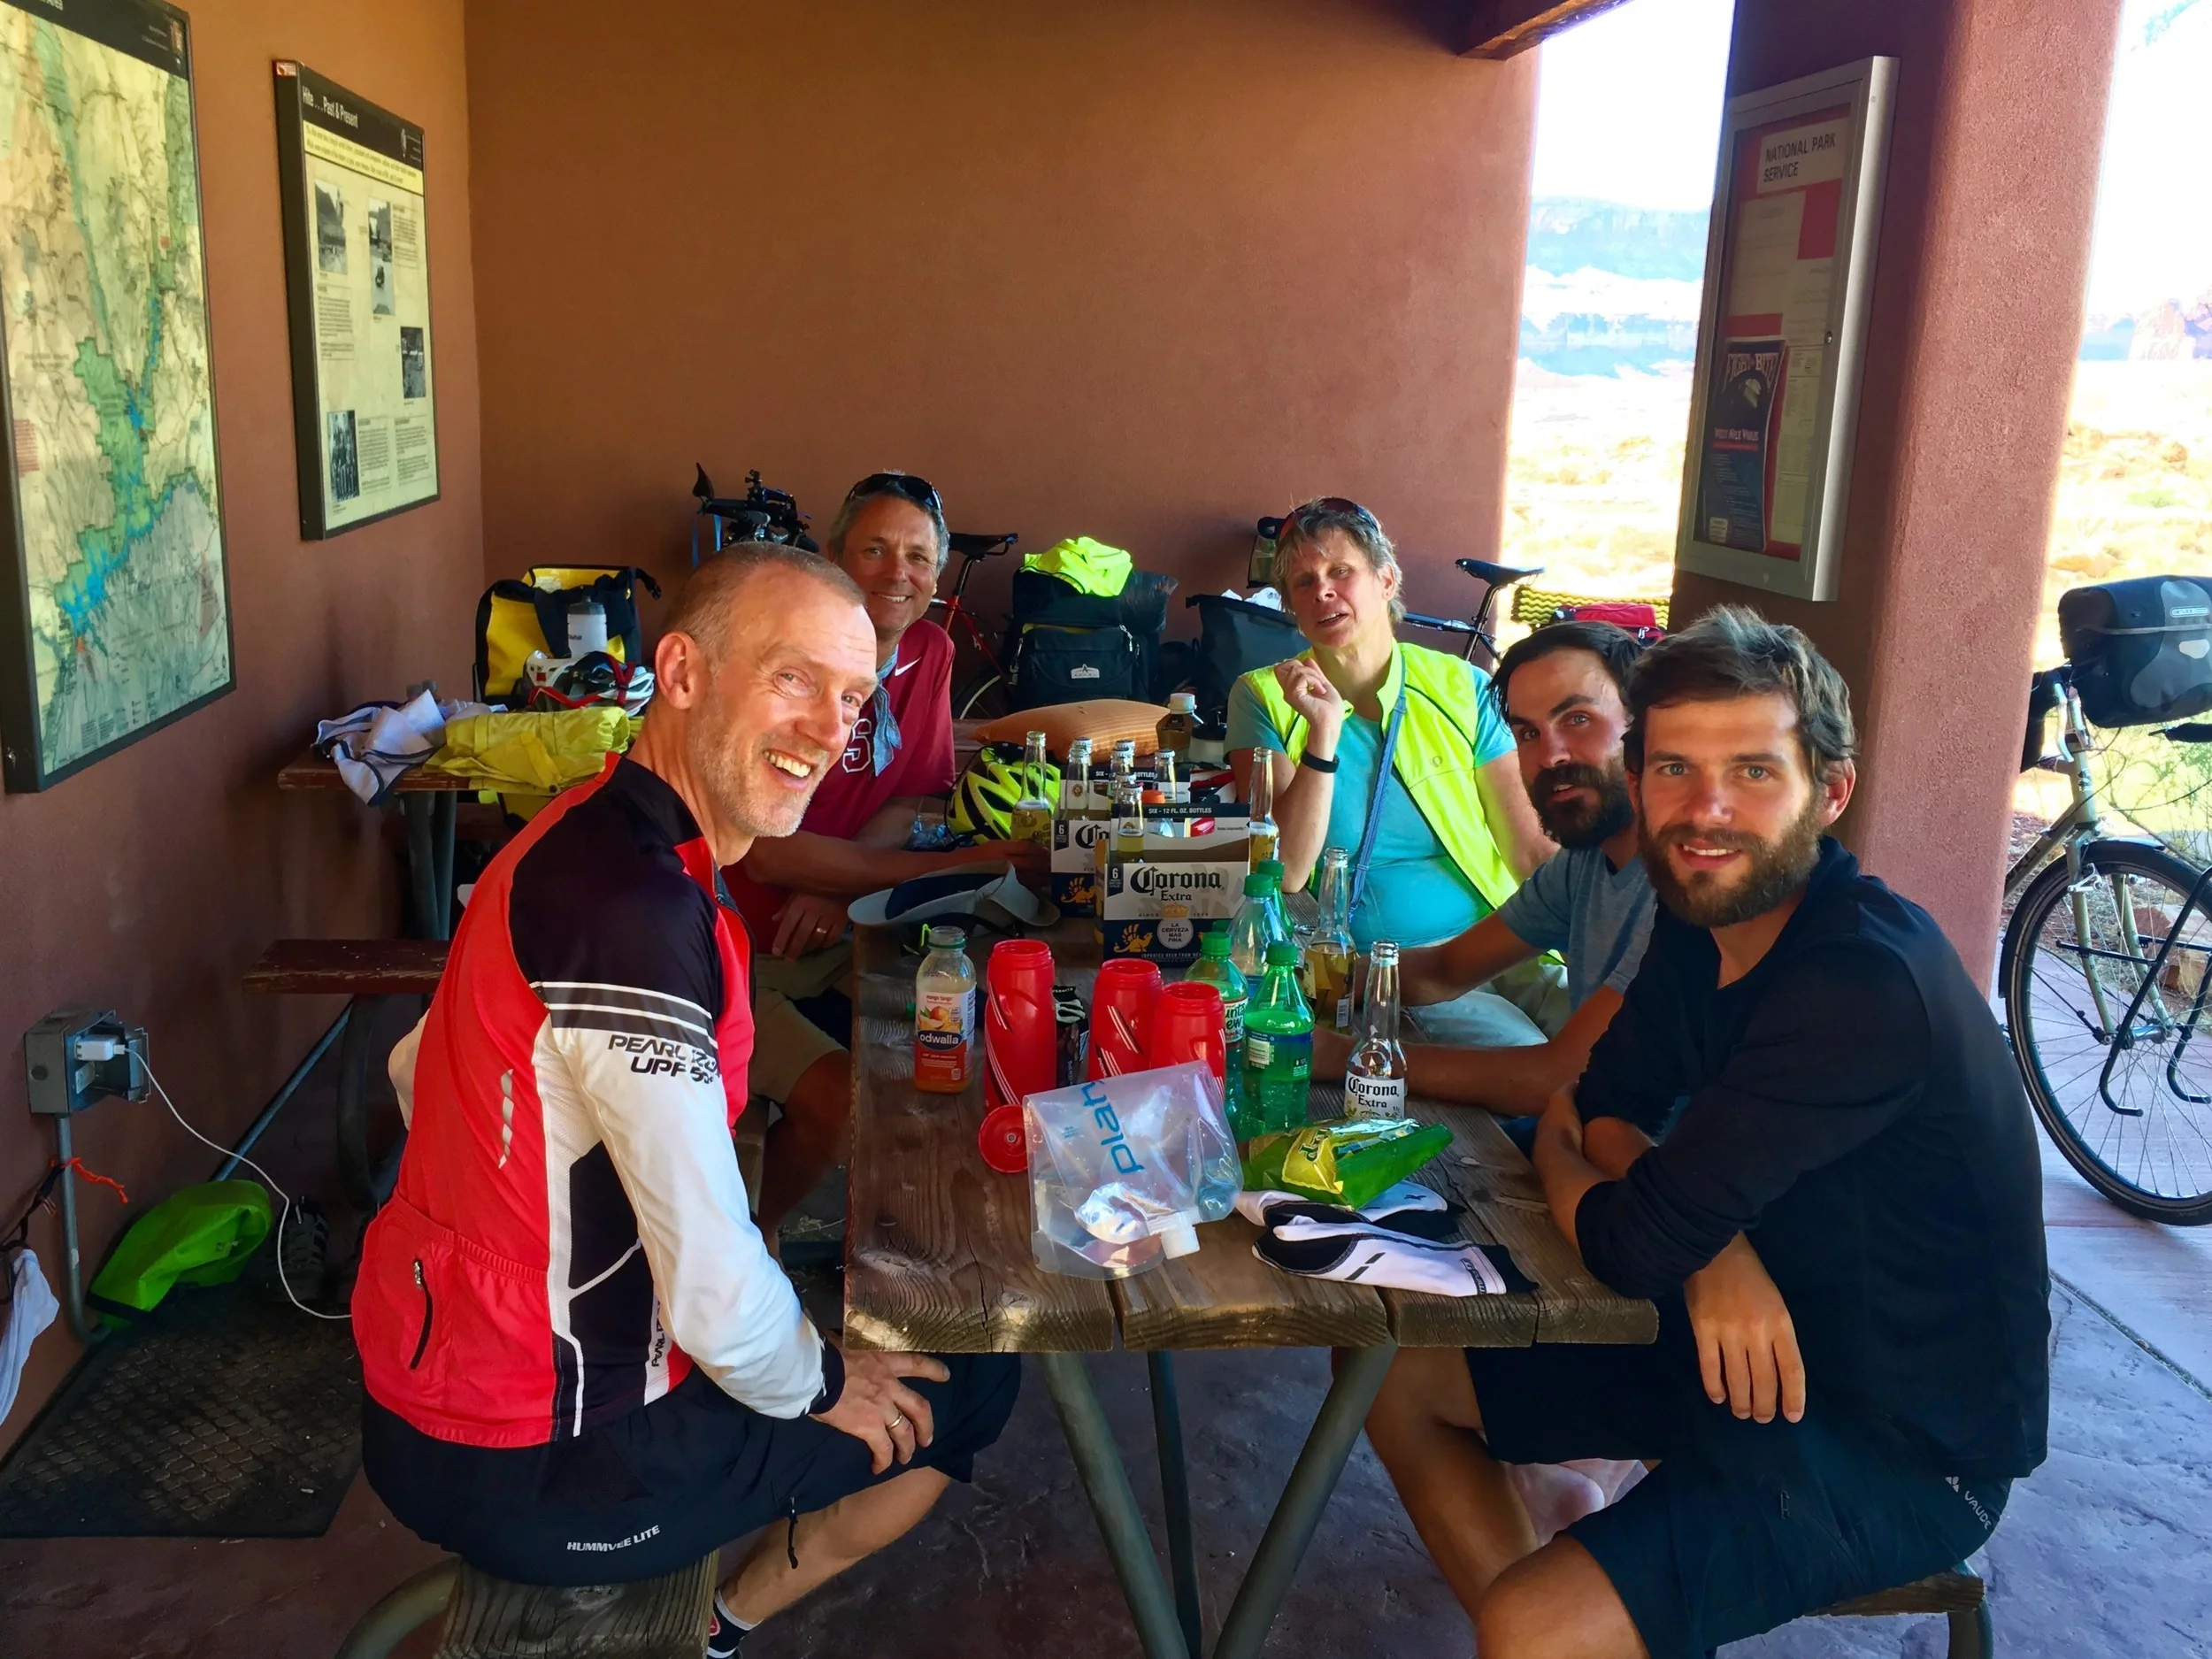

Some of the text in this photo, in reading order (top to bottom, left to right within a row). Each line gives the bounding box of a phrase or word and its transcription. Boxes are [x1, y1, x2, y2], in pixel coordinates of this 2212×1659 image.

[323, 96, 335, 117] Past
[340, 104, 358, 128] Present
[1765, 133, 1837, 163] NATIONAL PARK
[1763, 161, 1800, 183] SERVICE
[1058, 824, 1065, 835] 6
[1111, 867, 1119, 879] 6
[1130, 866, 1223, 896] Corona
[1161, 890, 1193, 902] Extra
[1225, 1018, 1243, 1030] ew
[608, 1034, 687, 1061] PEARL
[919, 1033, 959, 1045] odwalla
[630, 1056, 687, 1077] UPF
[1348, 1076, 1398, 1096] Corona
[1357, 1094, 1387, 1109] Extra
[1964, 1490, 1993, 1531] VAUDE
[566, 1525, 661, 1553] HUMMVEE LITE
